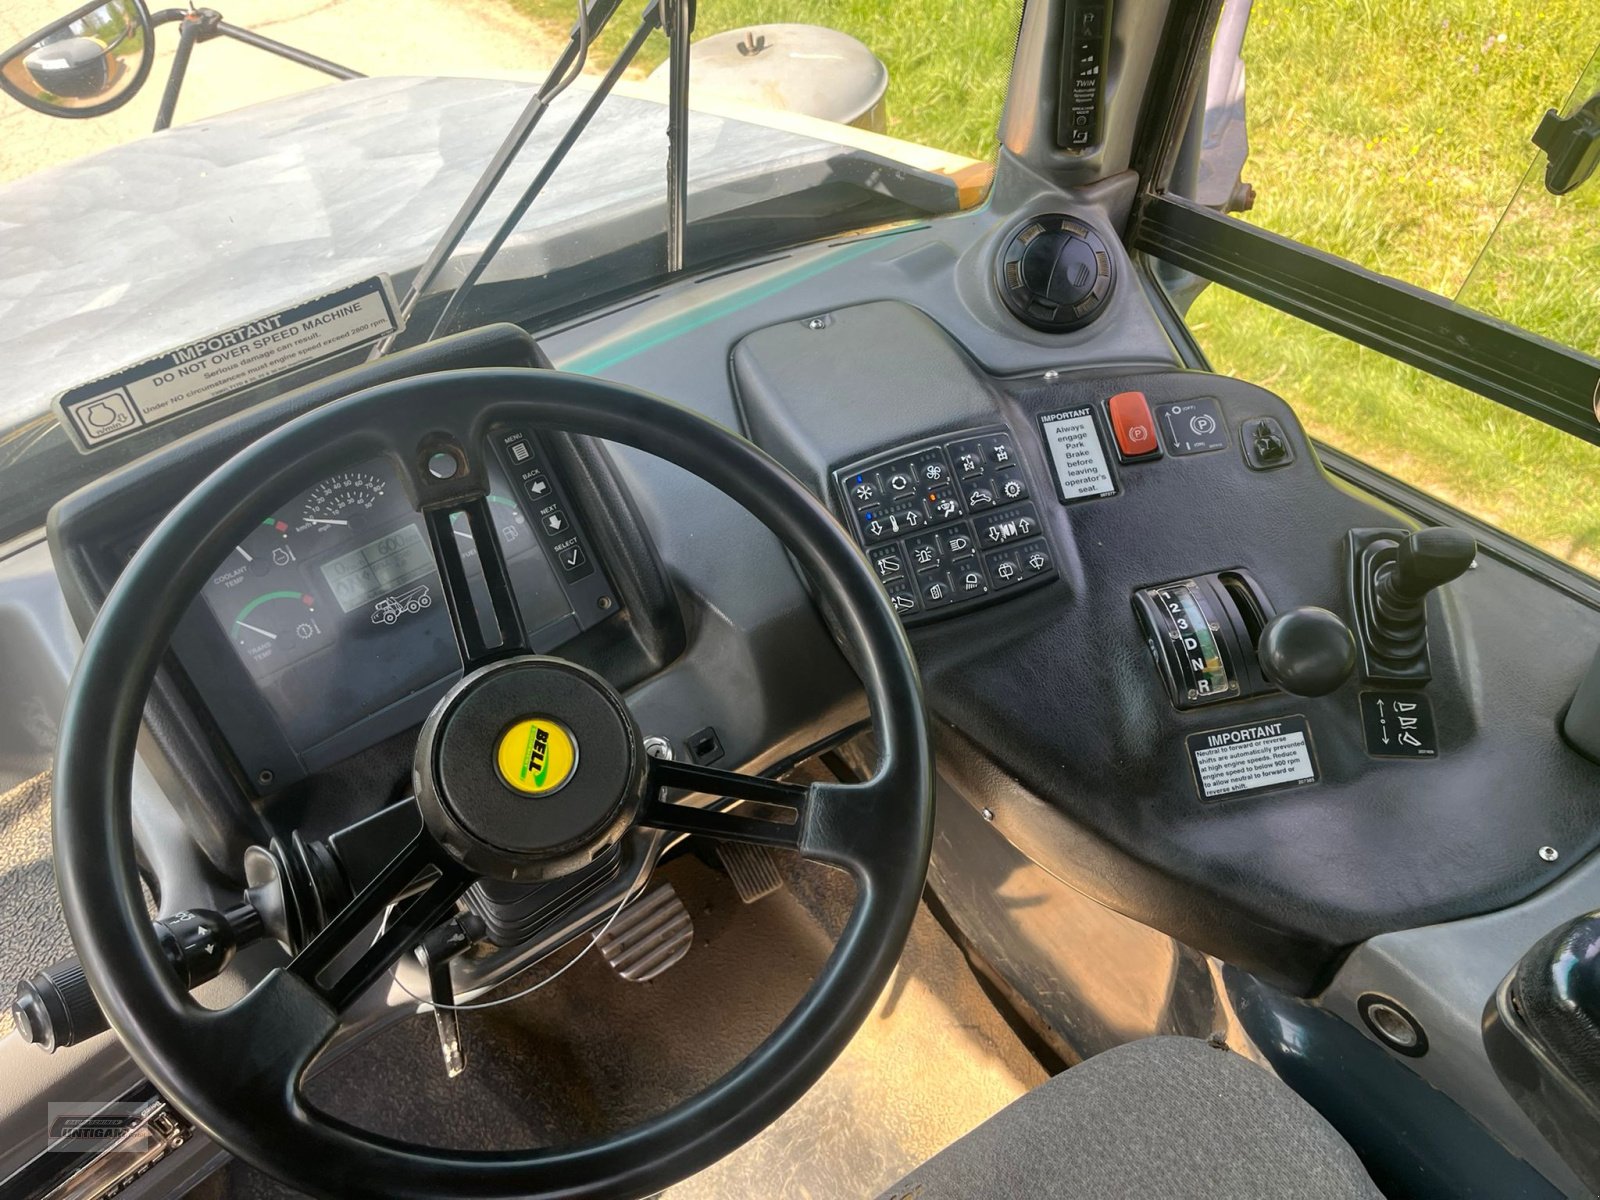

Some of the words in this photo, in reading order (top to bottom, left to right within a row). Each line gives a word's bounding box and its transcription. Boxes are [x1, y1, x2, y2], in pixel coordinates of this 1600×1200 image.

[152, 372, 175, 386] DO
[178, 359, 208, 377] NOT
[211, 343, 250, 364] OVER
[253, 325, 299, 349] SPEED
[302, 302, 362, 331] MACHINE
[171, 315, 282, 364] IMPORTANT
[204, 361, 238, 379] Serious
[239, 348, 275, 366] damage
[276, 342, 292, 352] can
[294, 331, 321, 345] result.
[142, 400, 169, 414] Under
[170, 394, 184, 403] NO
[185, 370, 245, 397] circumstances
[247, 362, 268, 374] must
[268, 351, 296, 366] engine
[297, 342, 321, 356] speed
[322, 331, 349, 345] exceed
[1041, 408, 1090, 422] IMPORTANT
[1056, 423, 1084, 434] Always
[1197, 420, 1207, 430] P
[504, 433, 523, 444] MENU
[1058, 432, 1087, 443] engage
[1066, 441, 1083, 449] Park
[1066, 450, 1089, 459] Brake
[1067, 458, 1093, 467] before
[522, 469, 541, 480] BACK
[1068, 466, 1097, 477] leaving
[1065, 474, 1106, 487] operator's
[540, 503, 557, 516] NEXT
[554, 537, 578, 552] SELECT
[213, 566, 247, 584] COOLANT
[225, 575, 244, 588] TEMP
[1162, 591, 1171, 599] 1
[1169, 603, 1181, 613] 2
[1177, 618, 1188, 630] 3
[1184, 637, 1197, 651] D
[1191, 657, 1205, 672] N
[1198, 679, 1210, 693] R
[1208, 723, 1282, 746] IMPORTANT
[528, 728, 549, 772] BELL
[1197, 748, 1219, 756] Neutral
[1229, 742, 1253, 751] forward
[1262, 736, 1286, 744] reverse
[1229, 746, 1271, 760] automatically
[1273, 741, 1304, 751] prevented
[1223, 759, 1245, 768] engine
[1246, 754, 1271, 764] speeds.
[1272, 749, 1296, 758] Reduce
[1202, 771, 1224, 781] engine
[1225, 768, 1244, 776] speed
[1254, 762, 1272, 770] below
[1230, 774, 1252, 782] neutral
[1262, 767, 1286, 776] forward
[1206, 787, 1229, 795] reverse
